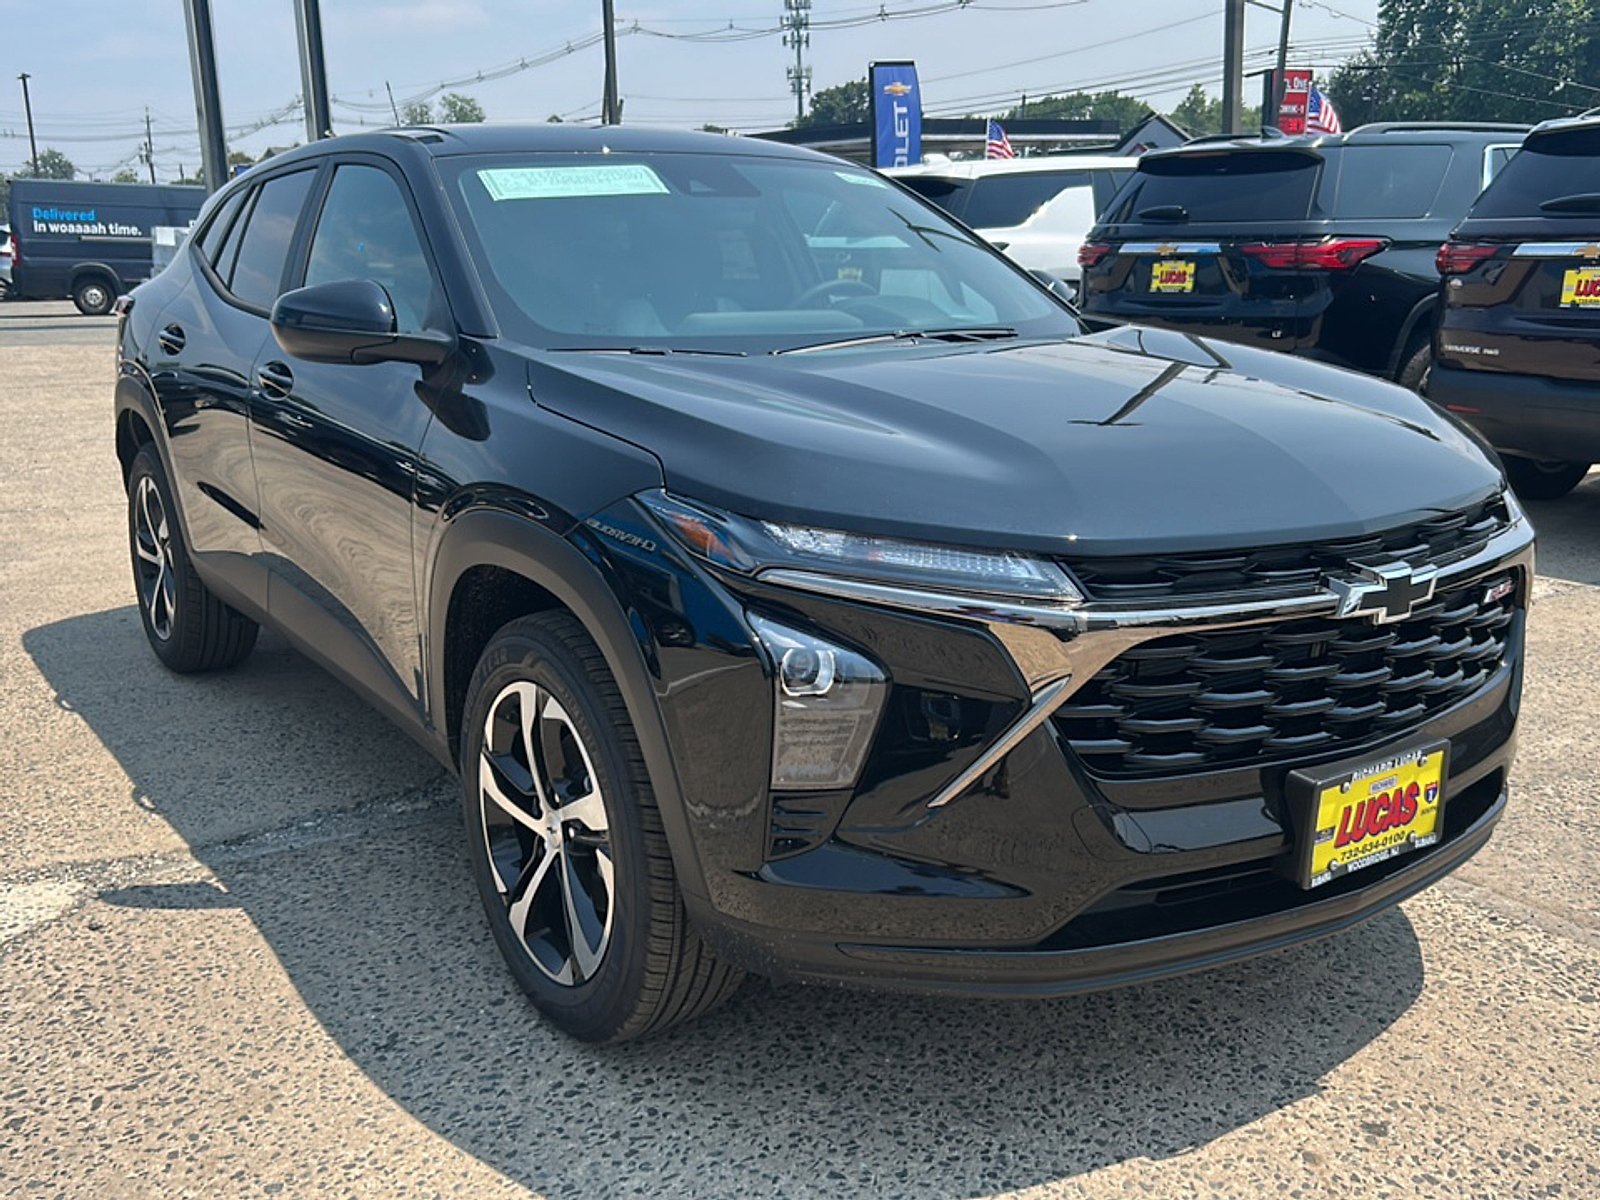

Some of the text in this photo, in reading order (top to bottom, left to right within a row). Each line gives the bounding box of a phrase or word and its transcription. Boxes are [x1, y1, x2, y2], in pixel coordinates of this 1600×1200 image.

[32, 207, 96, 222] Delivered
[49, 222, 108, 235] woaaaah
[108, 222, 143, 237] time.
[1159, 269, 1188, 285] LUCAS
[1334, 782, 1420, 849] LUCAS
[1340, 830, 1406, 862] 732-634-0100
